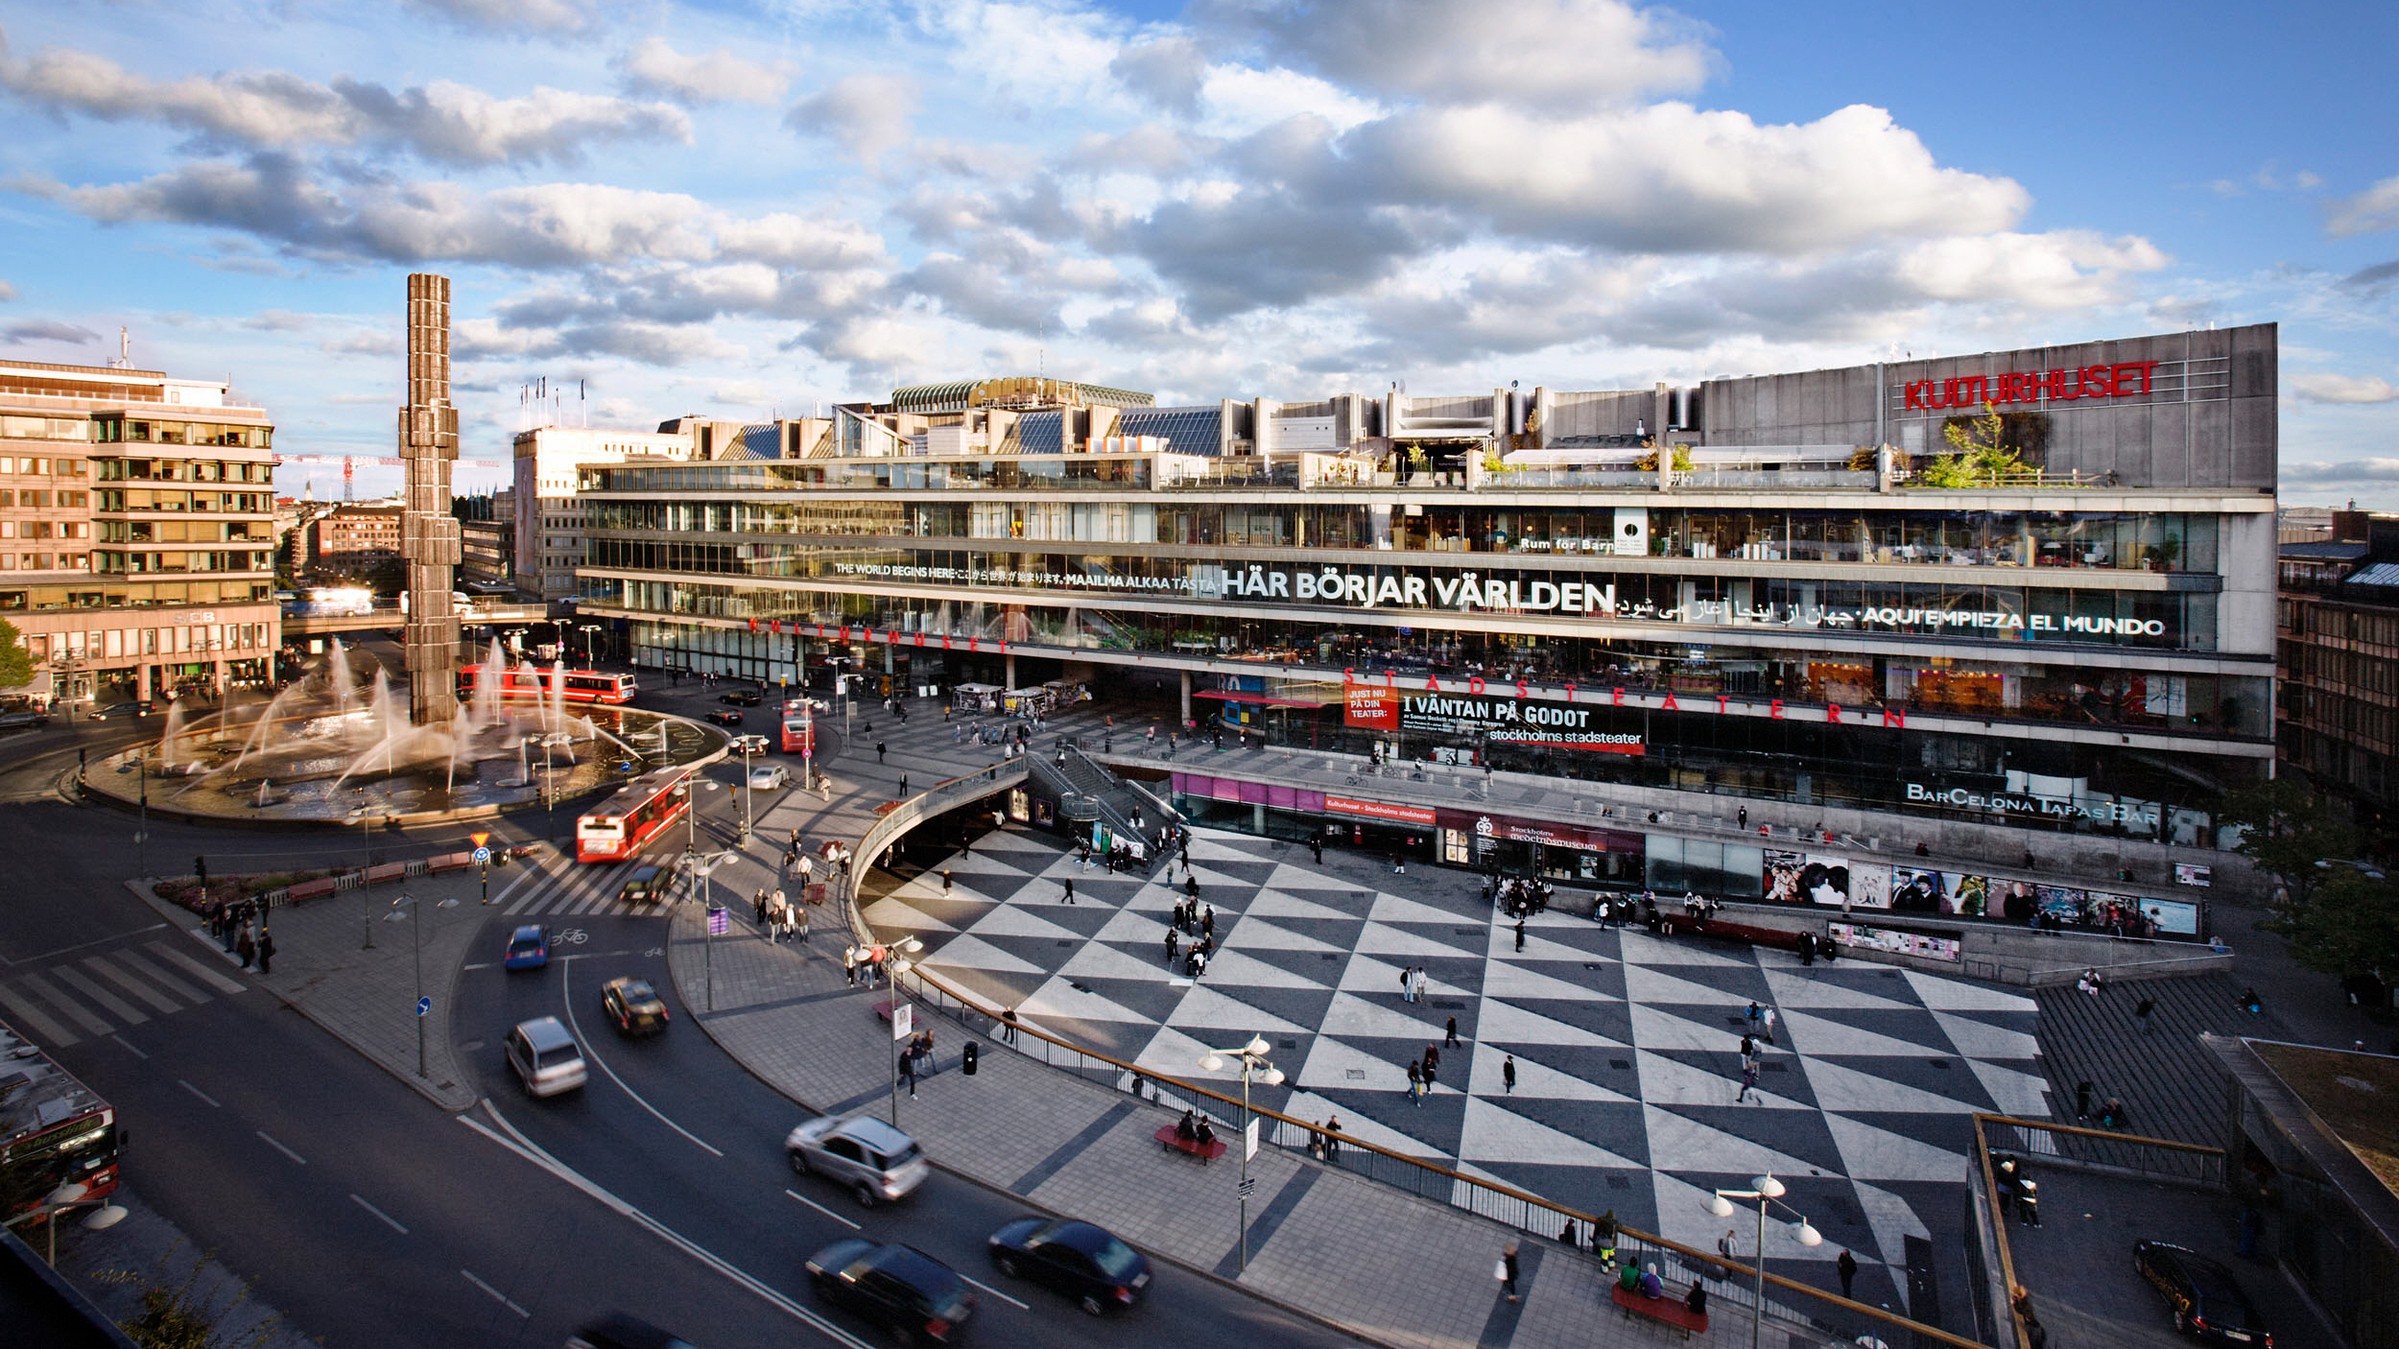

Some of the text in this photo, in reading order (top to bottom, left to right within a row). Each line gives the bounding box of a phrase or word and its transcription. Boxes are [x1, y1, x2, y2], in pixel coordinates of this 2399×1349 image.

[1904, 360, 2159, 411] KULTURHUSET
[1520, 538, 1550, 549] Rum
[1555, 538, 1576, 550] för
[1581, 539, 1614, 551] Barn
[835, 563, 955, 579] THE WORLD BEGINS HERE
[1066, 573, 1124, 588] MAAILMA
[1126, 577, 1168, 590] ALKAA
[1222, 564, 1615, 613] HÄR BÖRJAR VÄRLDEN
[2030, 613, 2059, 631] EL
[2064, 615, 2165, 636] MUNDO
[750, 618, 1008, 655] KULTURHUSET
[1343, 667, 1906, 729] STADSTEATERN
[1350, 689, 1386, 699] JUST NU
[1350, 698, 1381, 709] PÅ DIN
[1404, 694, 1590, 728] I VÄNTAN PÅ GODOT
[1351, 709, 1388, 718] TEATER:
[1489, 729, 1642, 744] stockholms stadsteater
[1327, 800, 1360, 810] Kulturhuset
[1364, 804, 1398, 816] Stockholms
[1399, 810, 1432, 820] stadsteater
[1510, 825, 1554, 837] Stockholms
